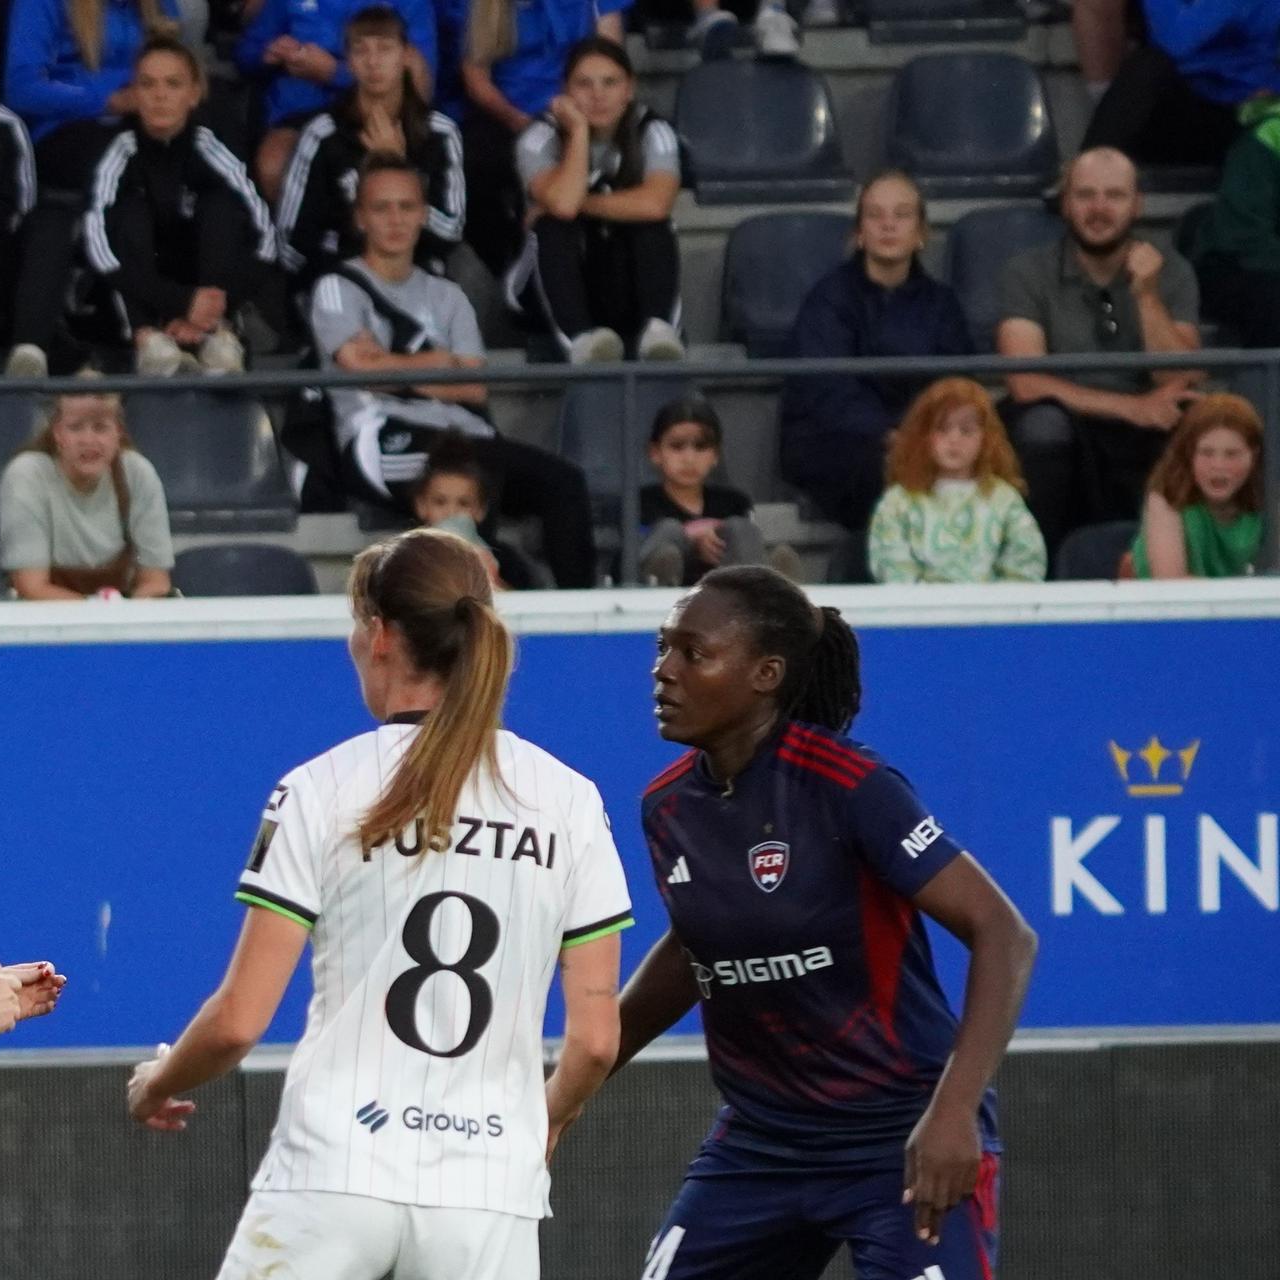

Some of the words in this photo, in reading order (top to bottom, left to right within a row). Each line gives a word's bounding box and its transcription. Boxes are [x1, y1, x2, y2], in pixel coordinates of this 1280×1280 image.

[1050, 812, 1280, 916] KIN
[385, 890, 501, 1058] 8
[402, 1106, 480, 1139] Group
[486, 1114, 504, 1137] S
